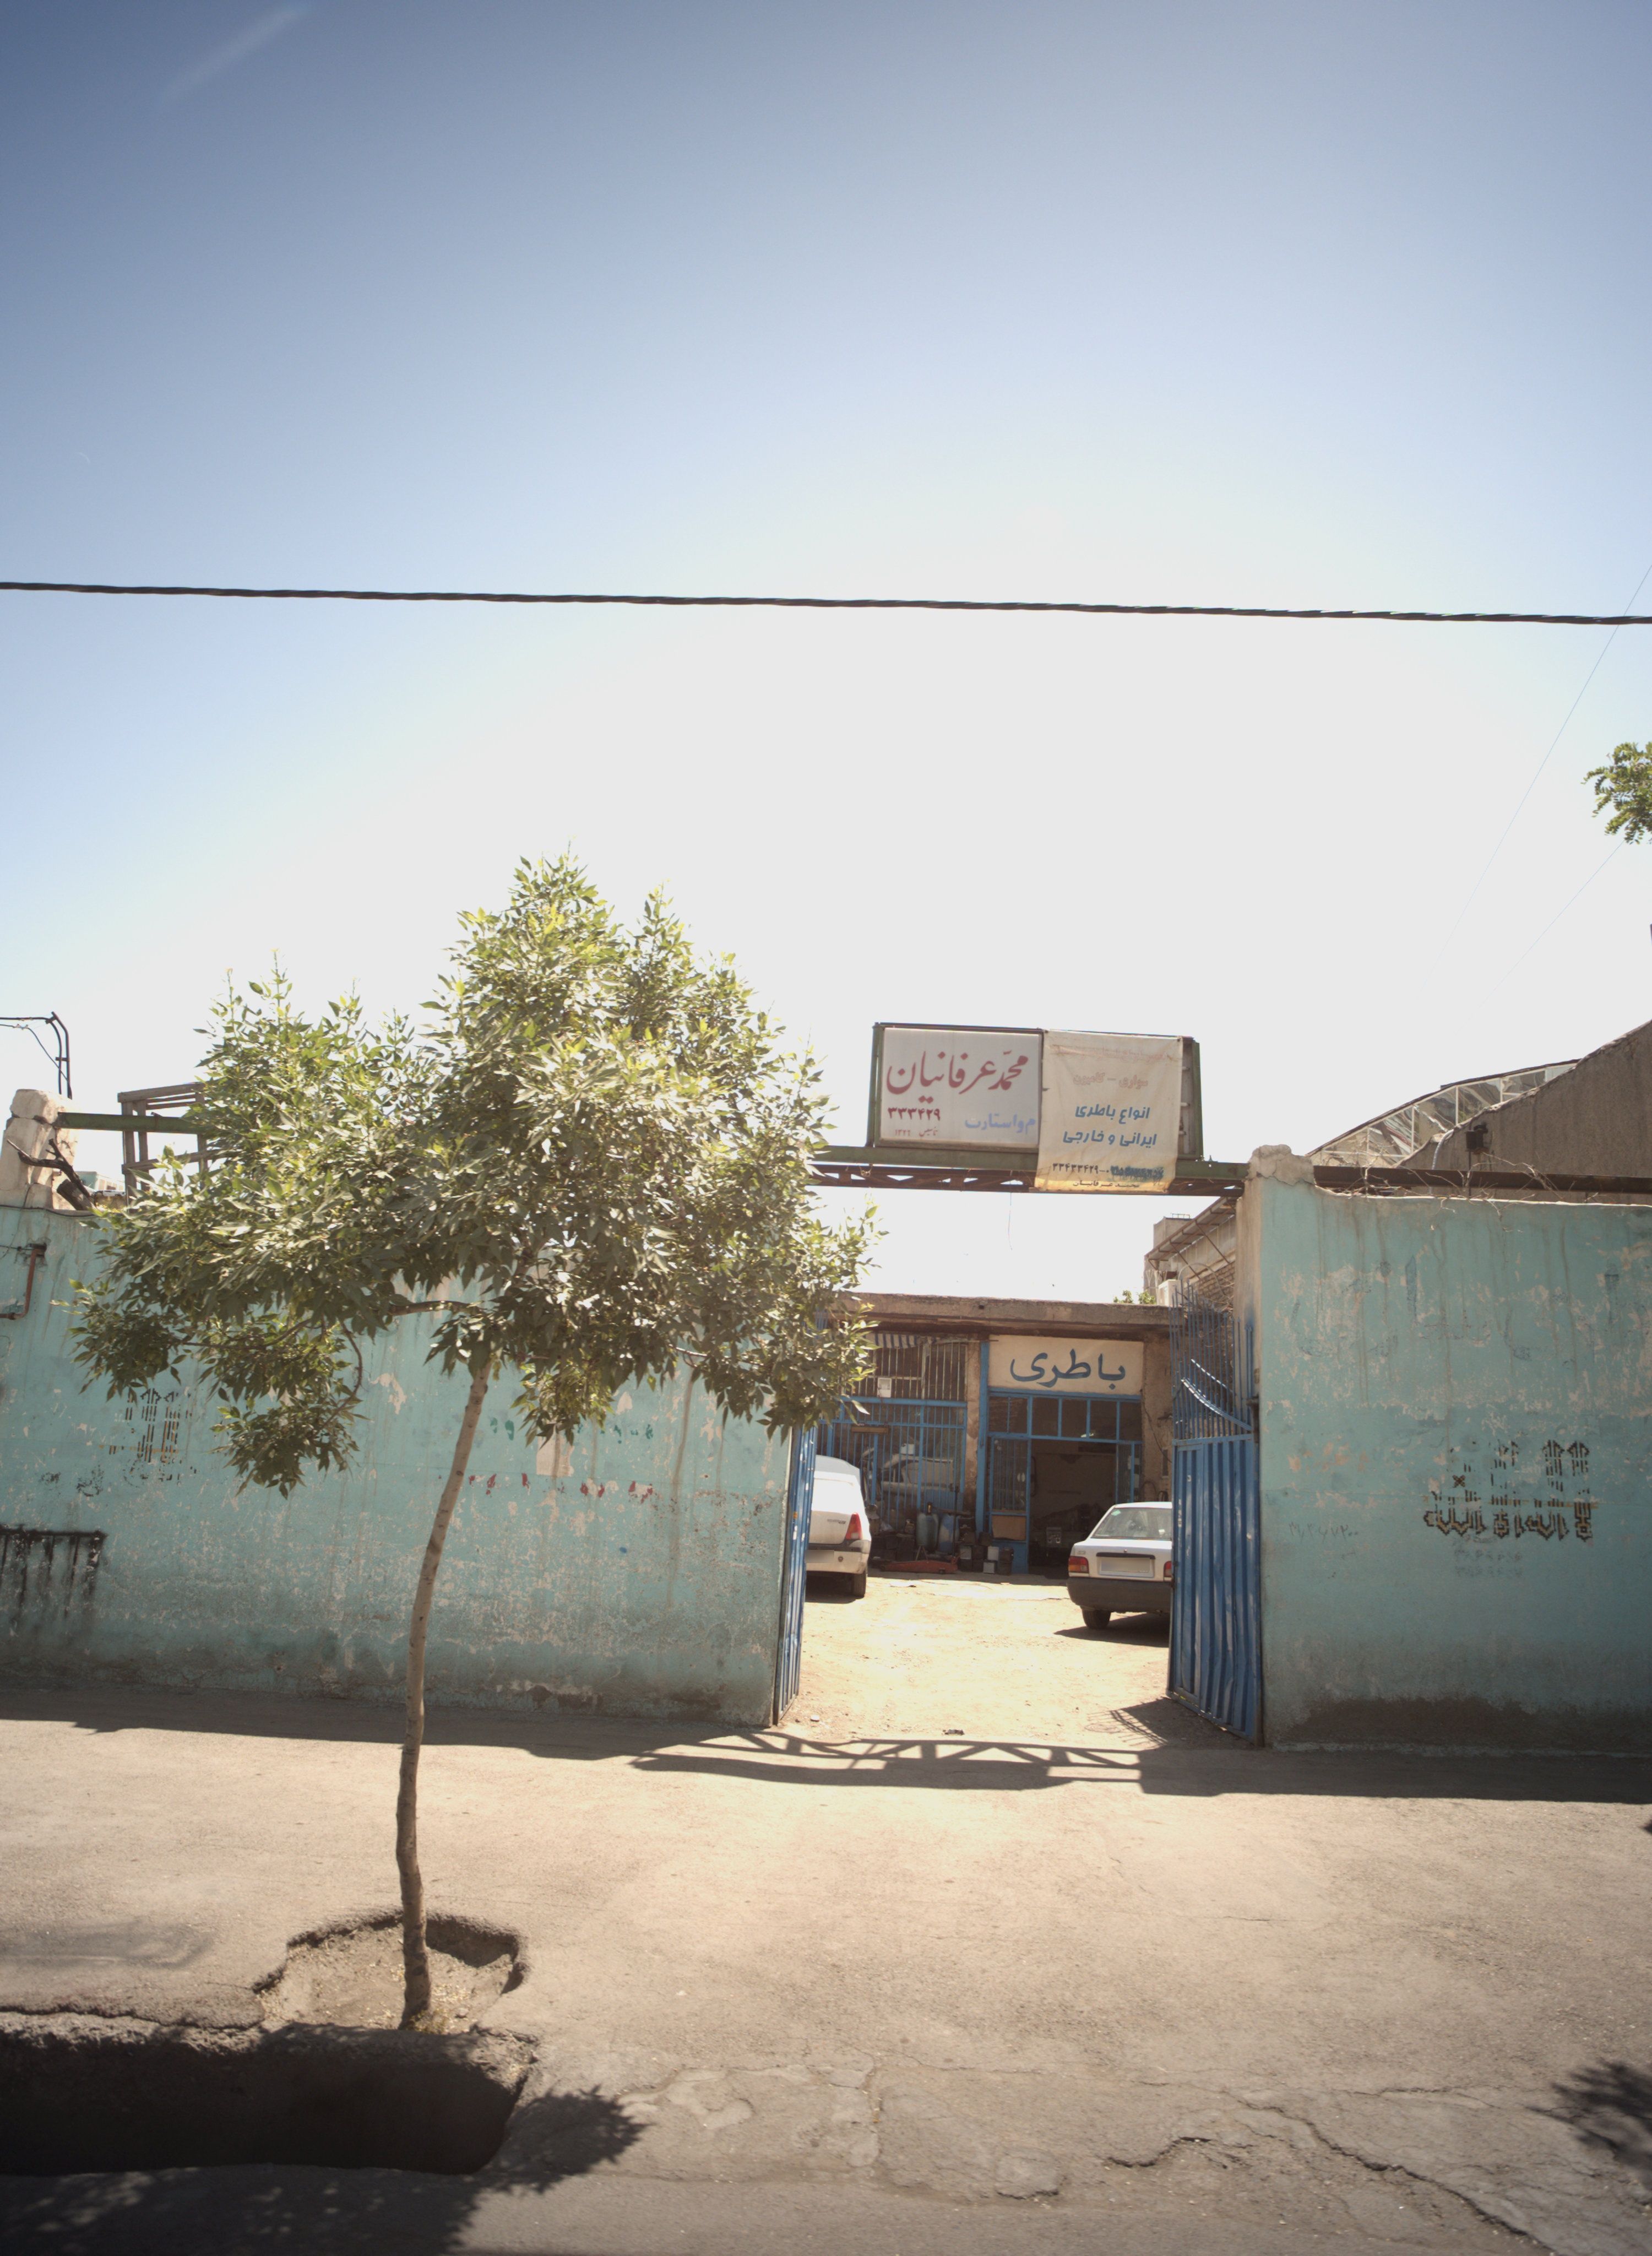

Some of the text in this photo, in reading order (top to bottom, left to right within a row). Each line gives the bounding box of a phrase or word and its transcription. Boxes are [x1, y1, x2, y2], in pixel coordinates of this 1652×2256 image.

[886, 1050, 996, 1104] عرفانیان
[1119, 1074, 1148, 1089] سواری
[888, 1107, 941, 1121] ۳۳۳۴۲۹
[1075, 1104, 1150, 1124] انواع باطری
[1063, 1130, 1157, 1148] ایرانی و خارجی
[1010, 1348, 1126, 1390] باطری
